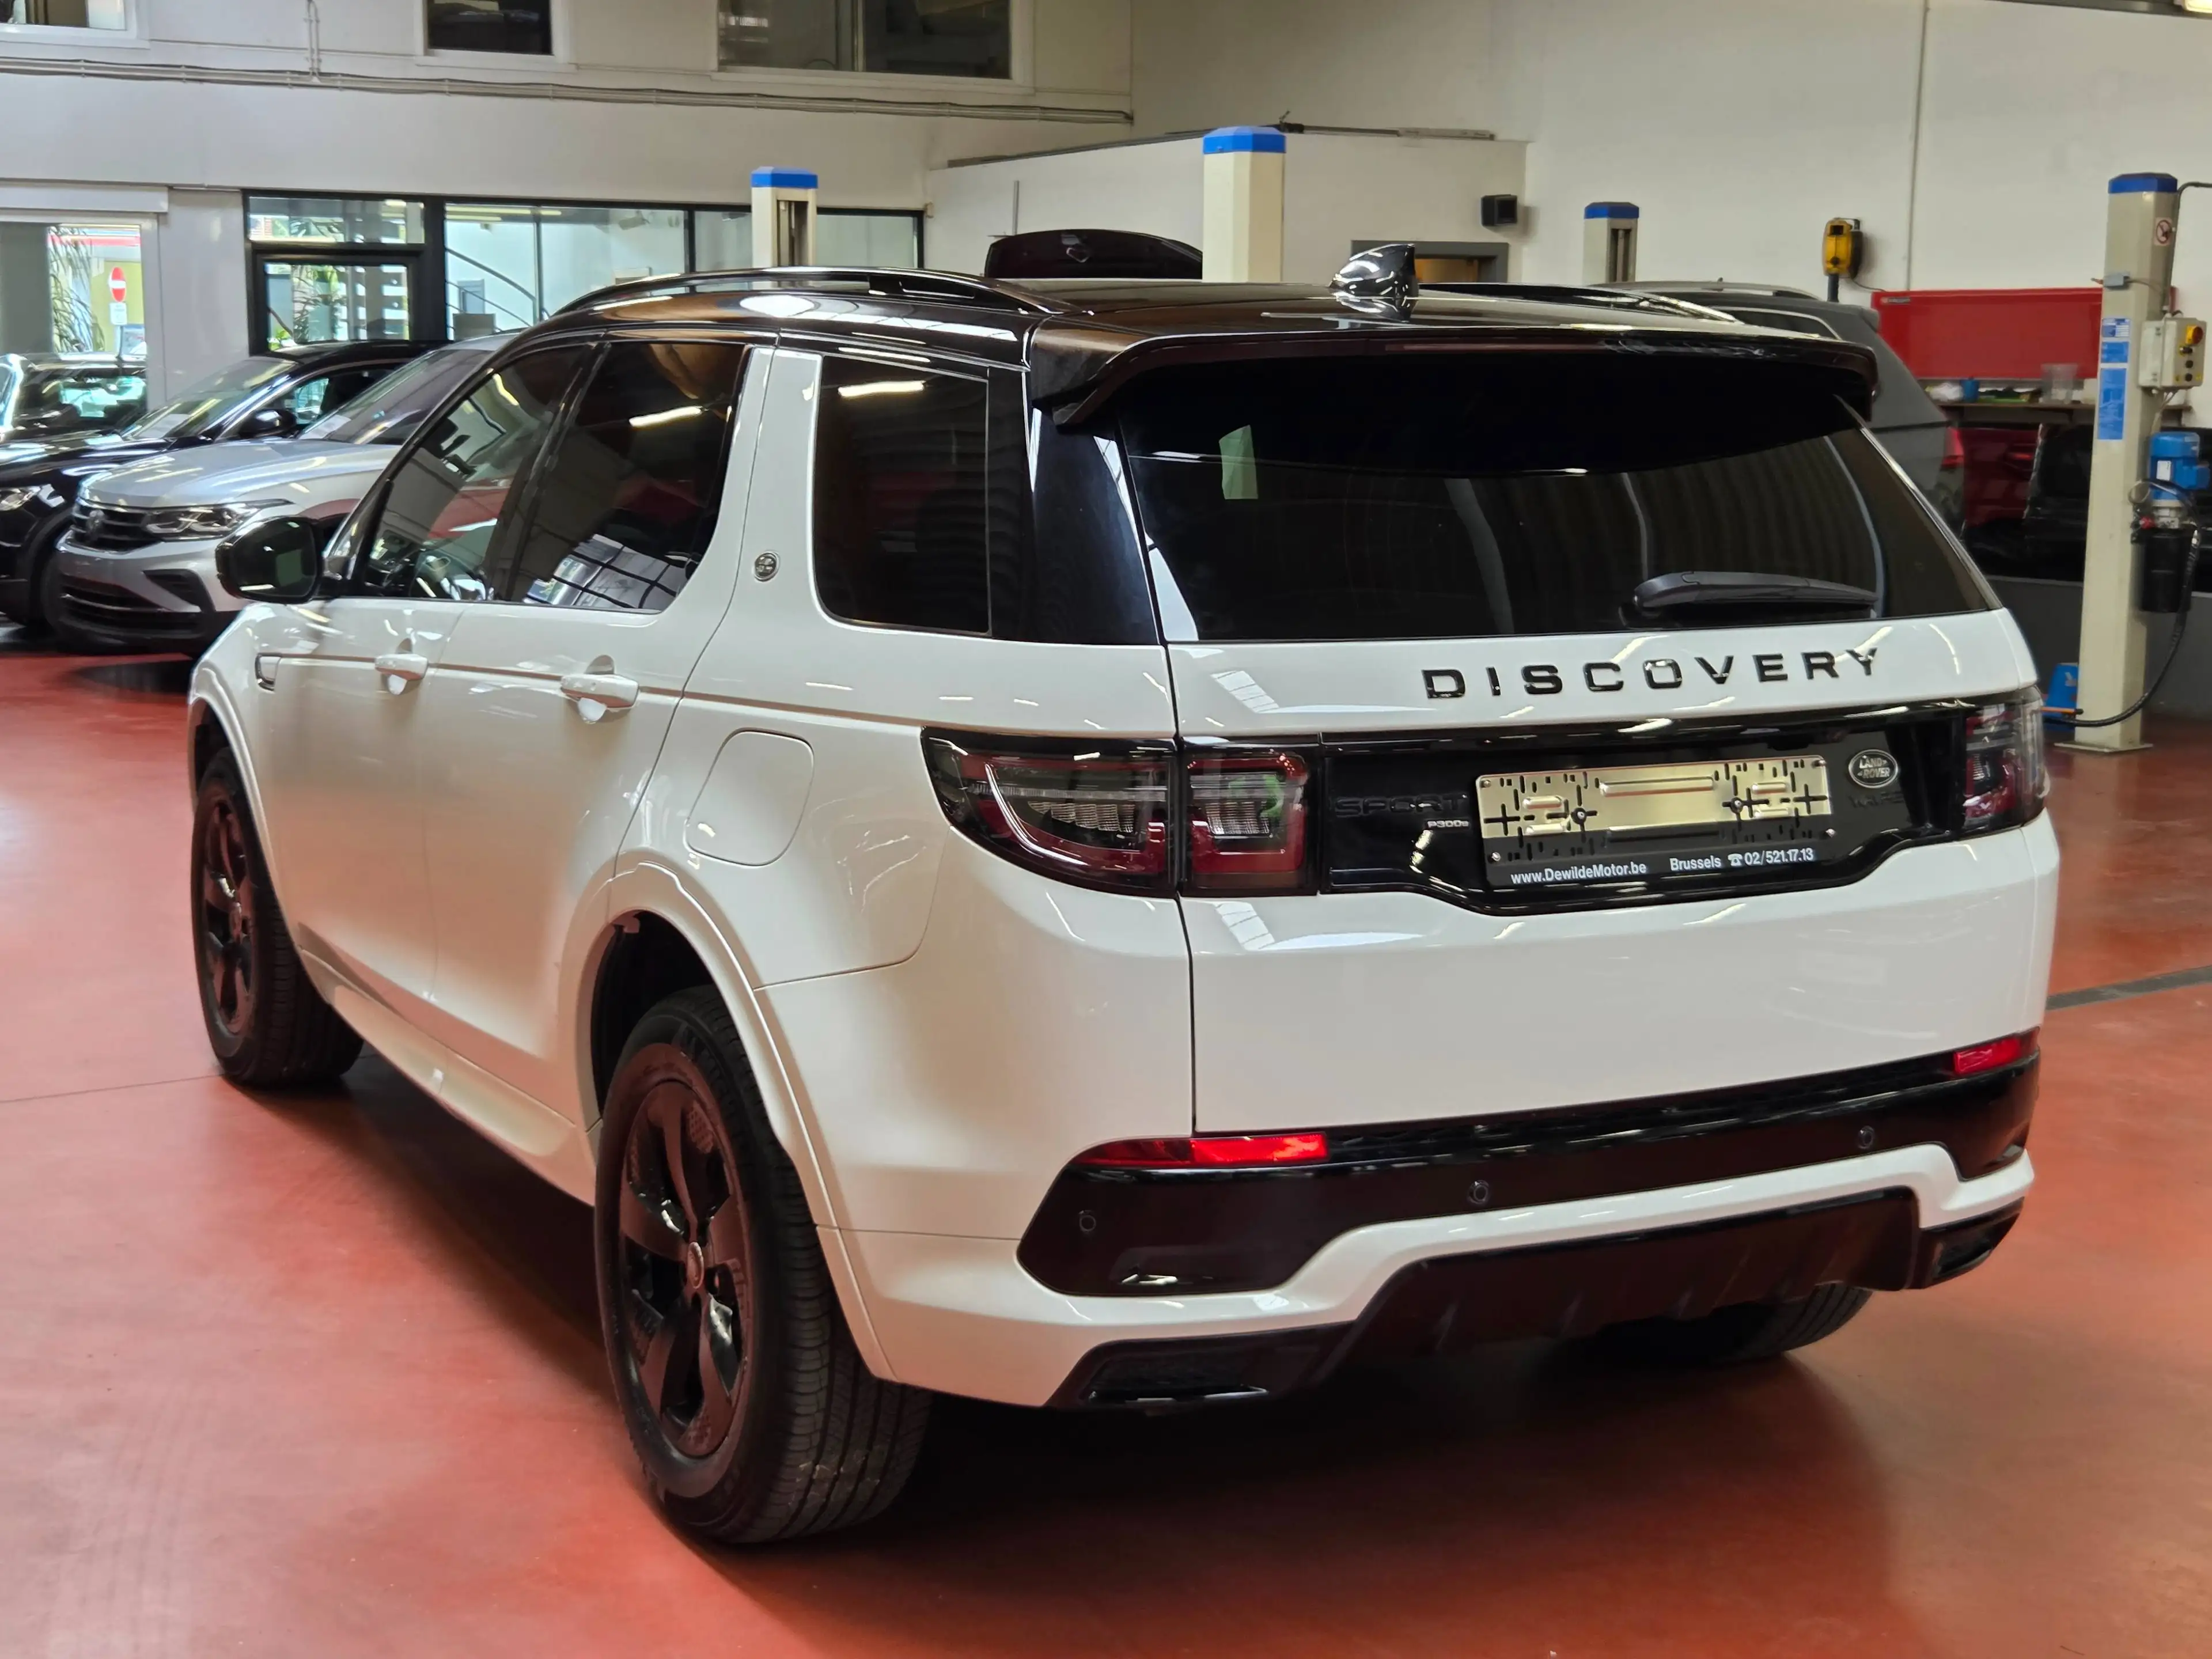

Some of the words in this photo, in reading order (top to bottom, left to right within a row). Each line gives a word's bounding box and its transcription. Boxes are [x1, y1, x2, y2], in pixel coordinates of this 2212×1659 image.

[1421, 647, 1877, 699] DISCOVERY
[1859, 755, 1884, 768] LAND
[1862, 767, 1890, 778] ROVER
[1335, 792, 1468, 816] SPORT
[1510, 861, 1647, 884] www.DewildeMotor.be
[1669, 855, 1722, 872] Brussels
[1744, 847, 1814, 866] 02/521.17.13
